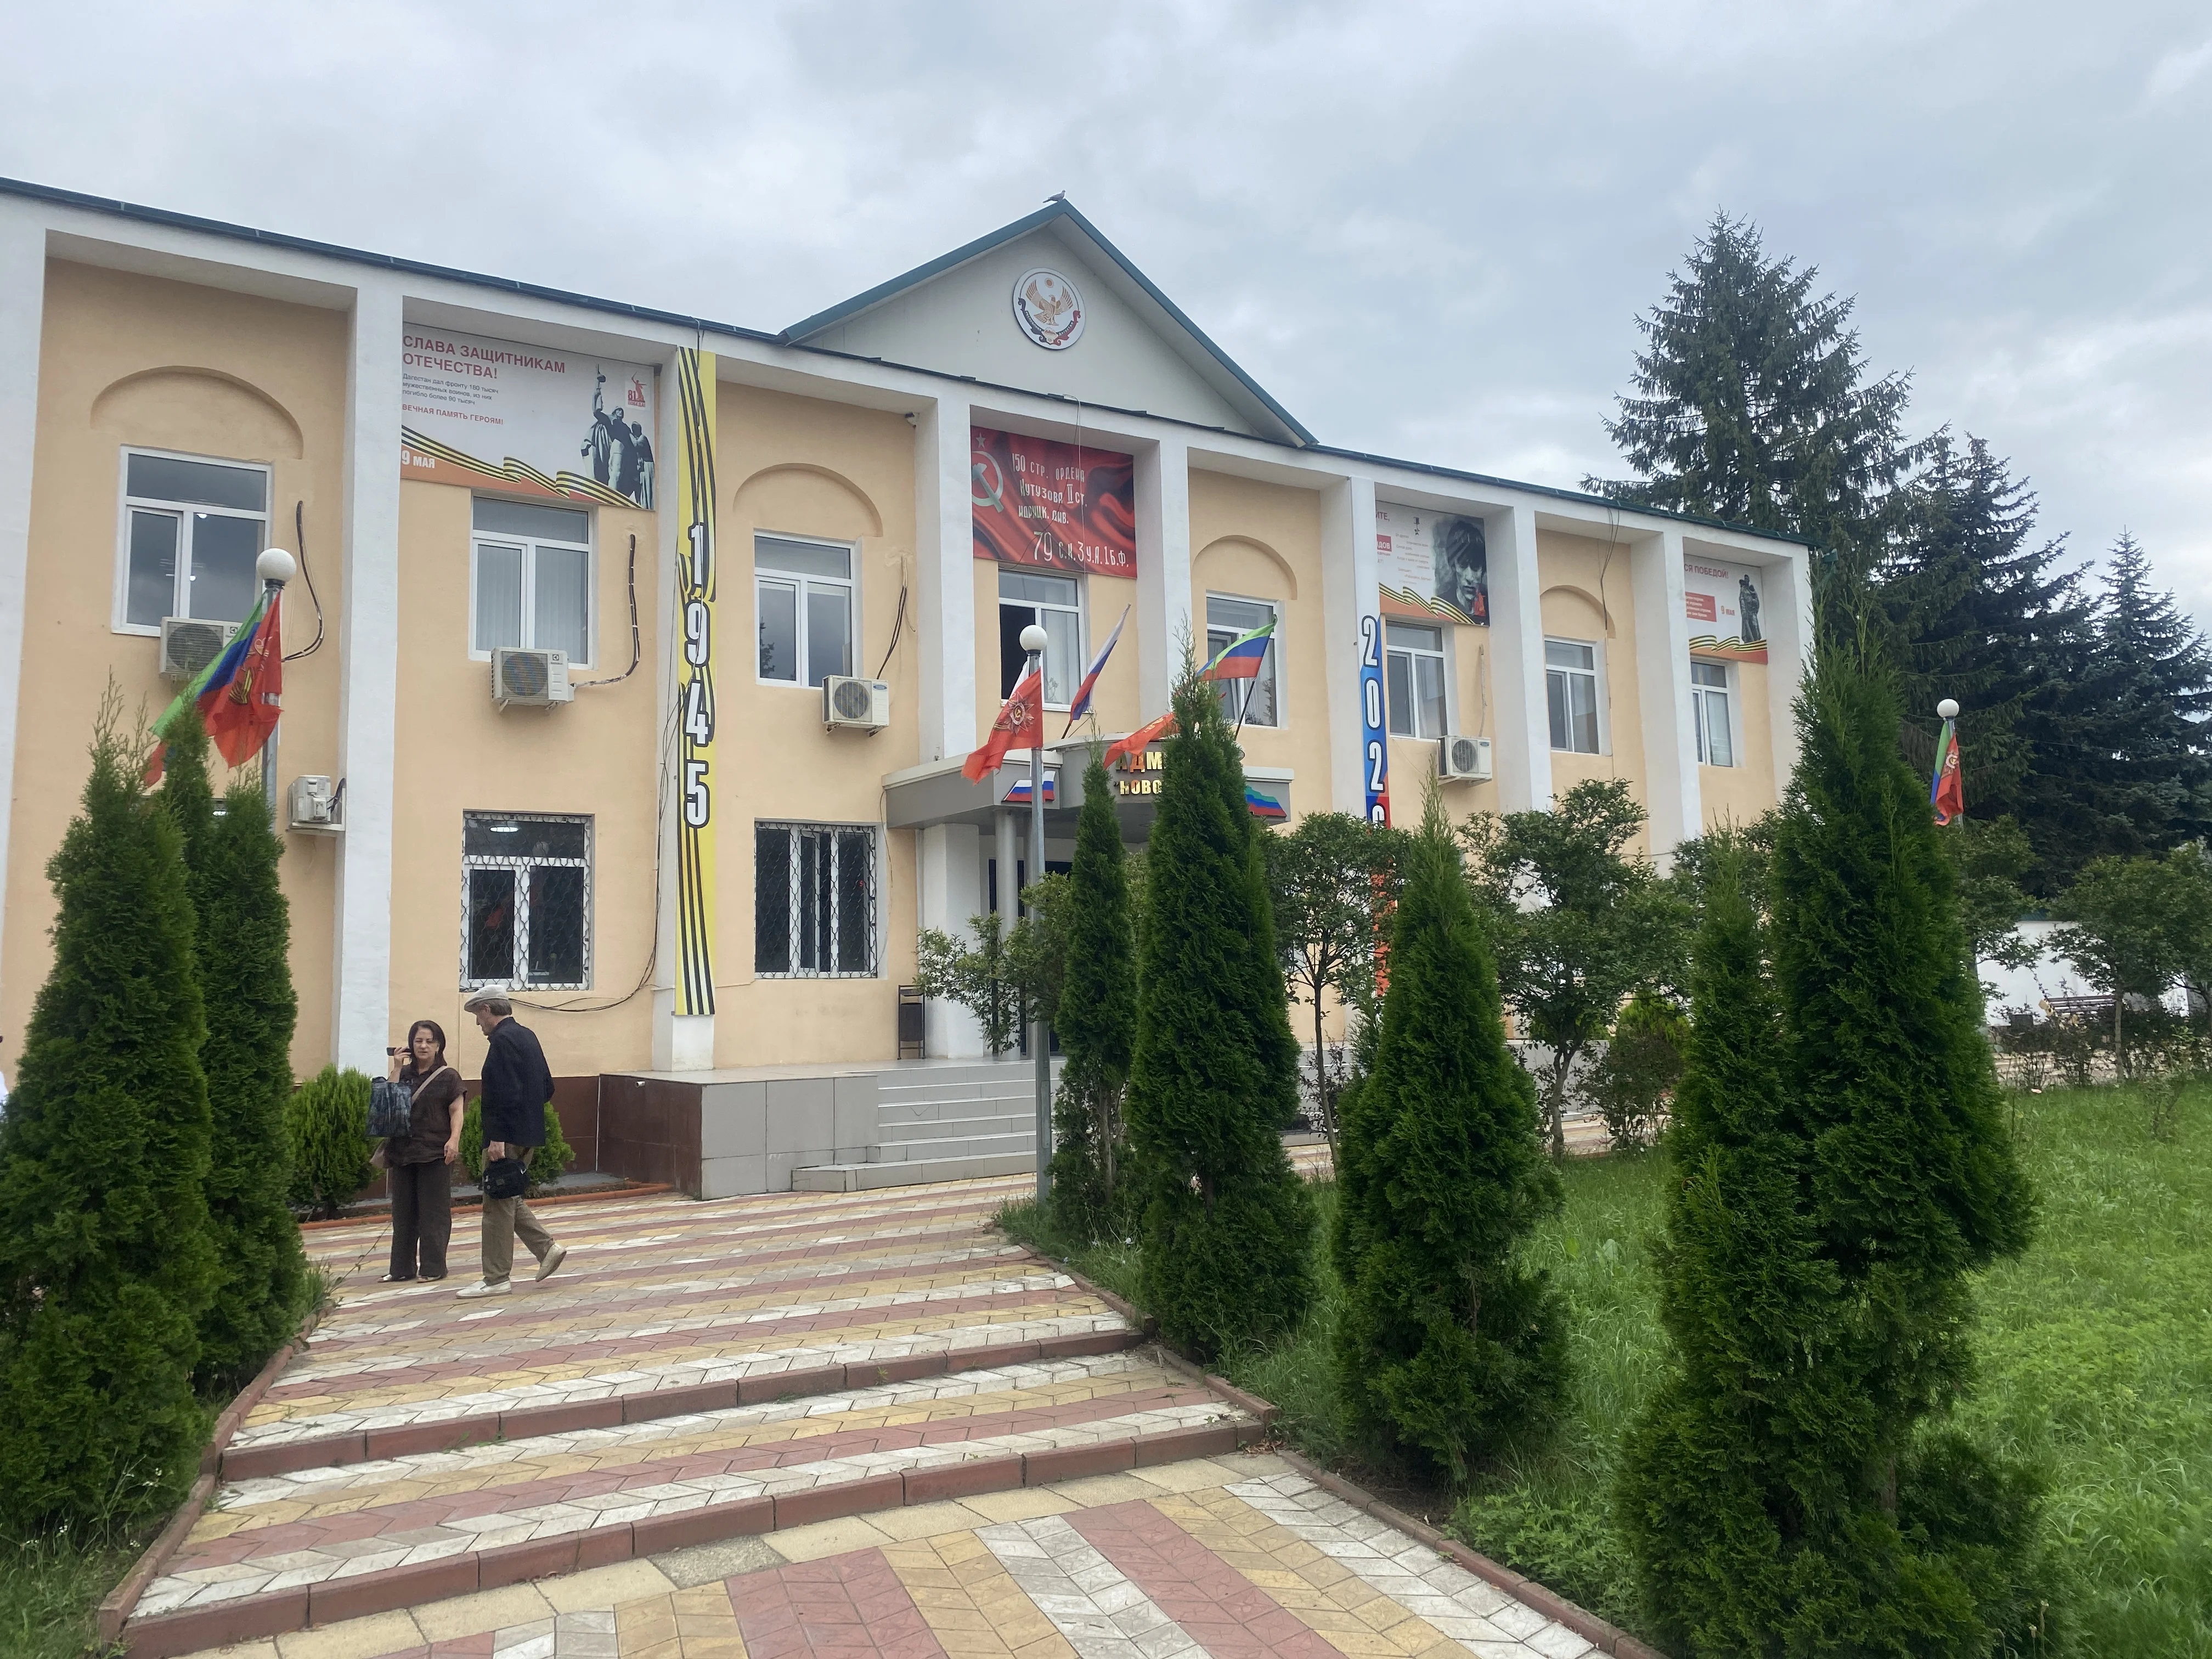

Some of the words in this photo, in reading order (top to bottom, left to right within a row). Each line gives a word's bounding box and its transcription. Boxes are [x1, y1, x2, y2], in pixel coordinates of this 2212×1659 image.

[403, 335, 455, 355] СЛАВА
[460, 345, 565, 374] ЗАЩИТНИКАМ
[403, 353, 498, 379] ОТЕЧЕСТВА!
[403, 373, 431, 383] Дагестан
[445, 381, 467, 390] фронту
[403, 382, 447, 393] мужественных
[449, 390, 471, 398] воинов,
[402, 390, 427, 398] погибло
[429, 393, 447, 401] более
[628, 390, 636, 401] 81
[402, 404, 434, 415] ВЕЧНАЯ
[436, 409, 468, 420] ПАМЯТЬ
[470, 414, 504, 425] ГЕРОЯМ!
[402, 450, 410, 465] 9
[413, 456, 435, 469] МАЯ
[1012, 453, 1026, 472] 150
[1034, 531, 1053, 561] 79
[1377, 541, 1391, 549] ДОВ
[1694, 566, 1729, 579] ПОБЕДОЙ!
[684, 522, 710, 828] 1945
[1115, 751, 1167, 773] АДМ
